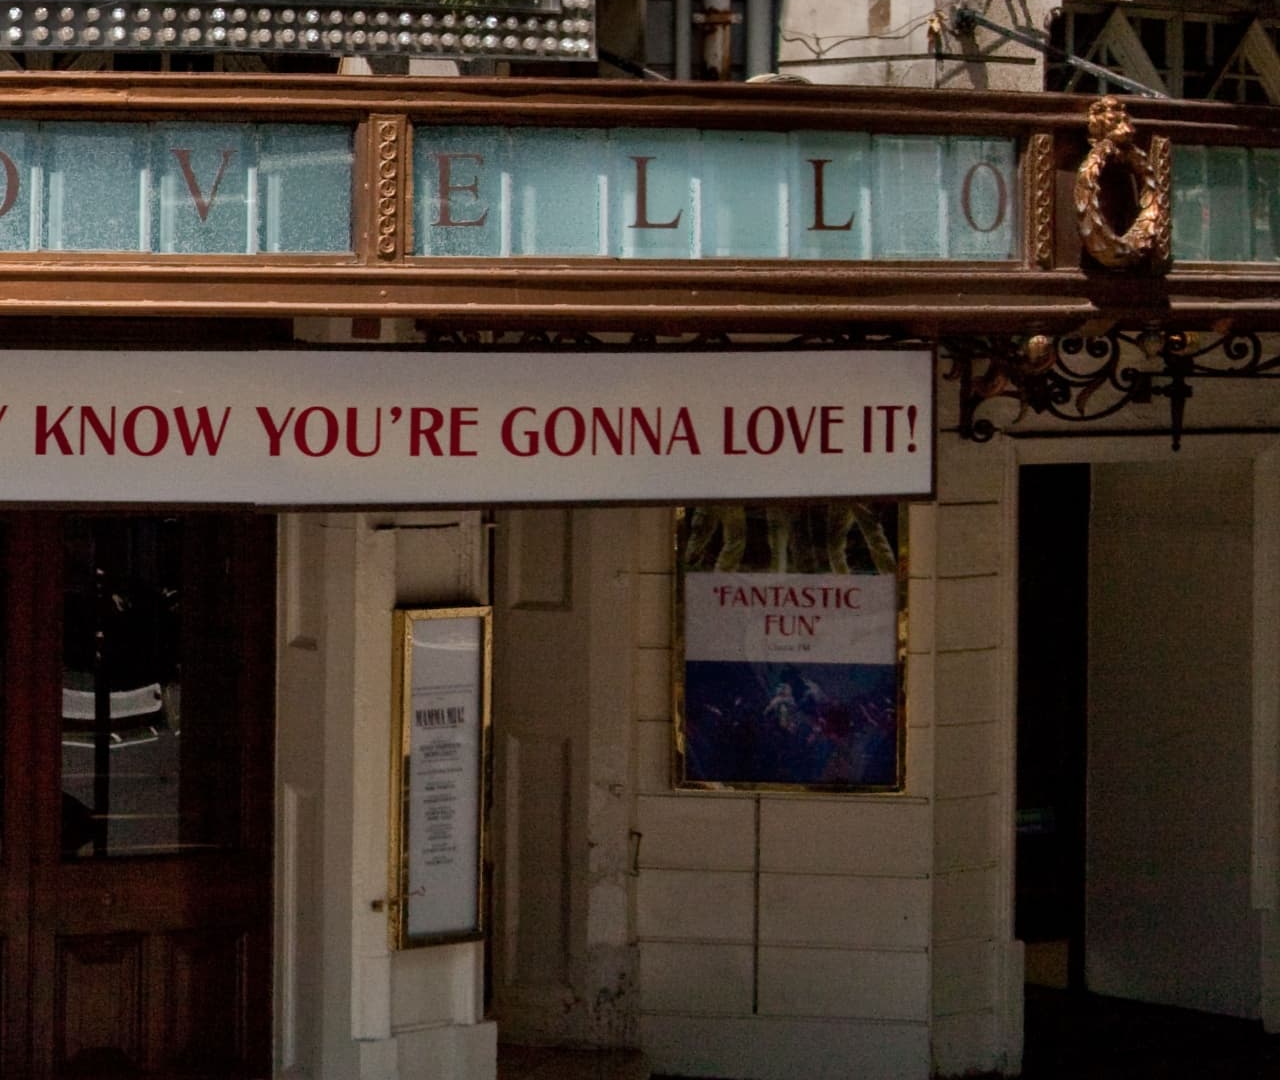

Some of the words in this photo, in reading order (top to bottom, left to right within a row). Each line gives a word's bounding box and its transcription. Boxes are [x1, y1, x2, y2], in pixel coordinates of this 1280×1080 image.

[36, 404, 233, 458] KNOW
[256, 405, 481, 459] YOU'RE
[501, 406, 702, 458] GONNA
[724, 406, 844, 458] LOVE
[865, 406, 919, 455] IT!
